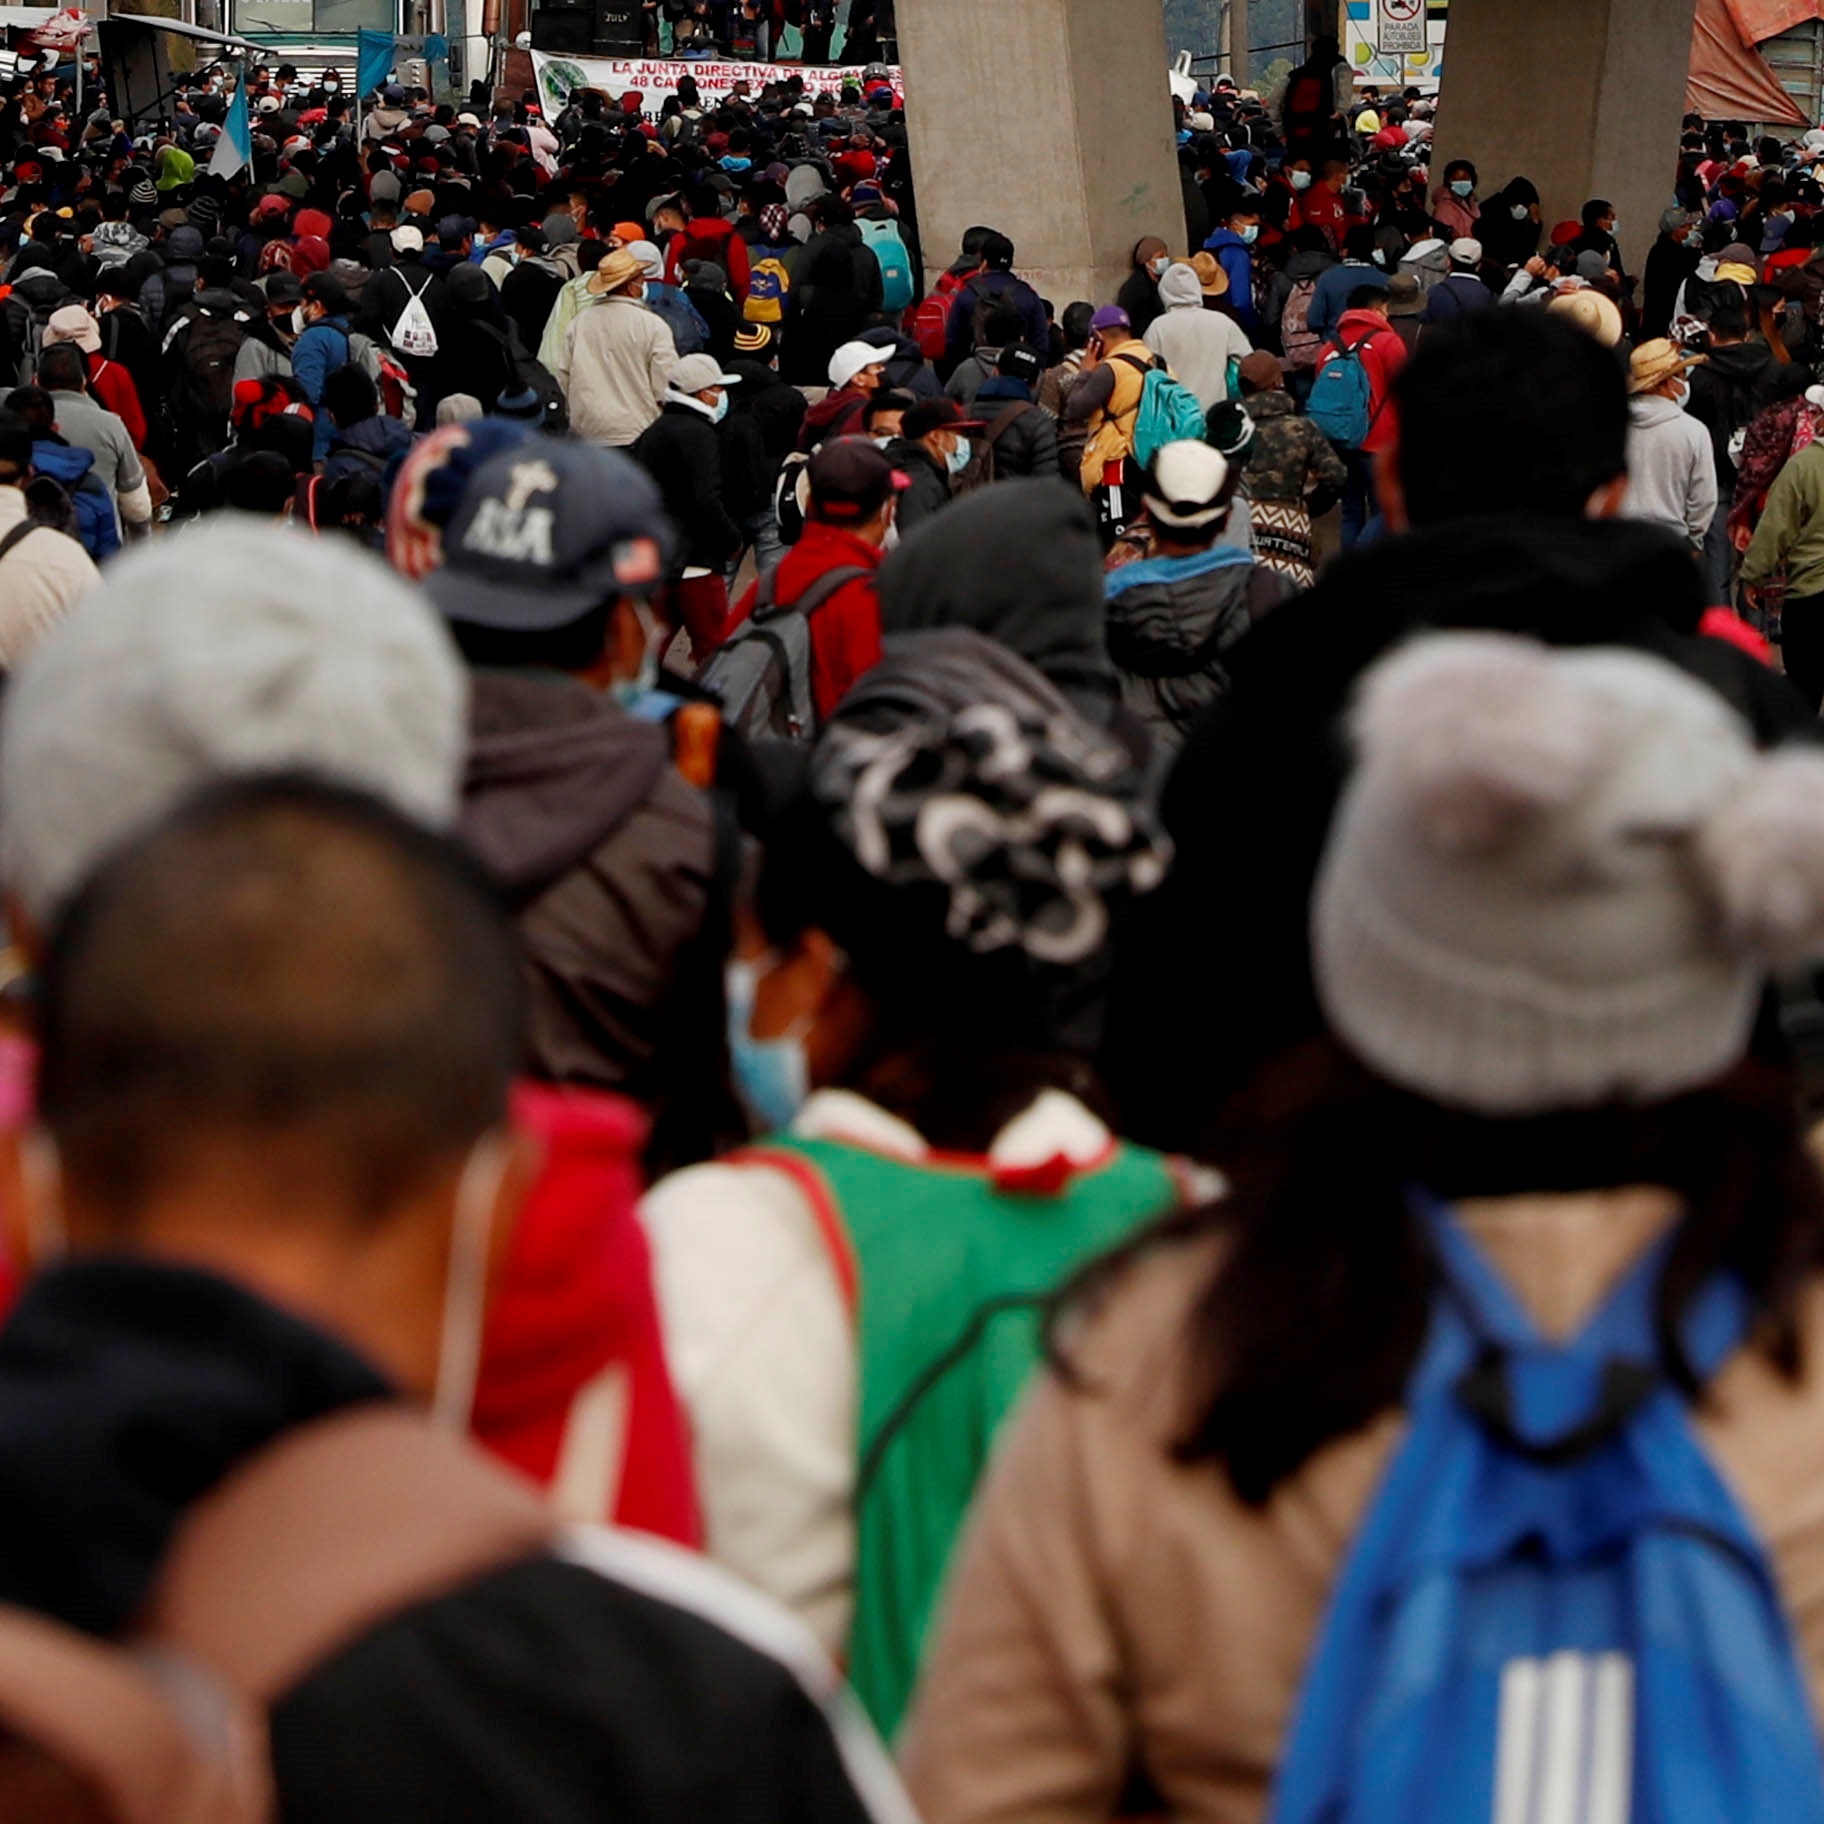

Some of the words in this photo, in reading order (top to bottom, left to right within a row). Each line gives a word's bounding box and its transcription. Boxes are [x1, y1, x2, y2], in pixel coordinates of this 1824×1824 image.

[612, 62, 631, 74] LA
[638, 62, 689, 74] JUNTA
[694, 64, 777, 76] DIRECTIVA
[630, 76, 648, 87] 48
